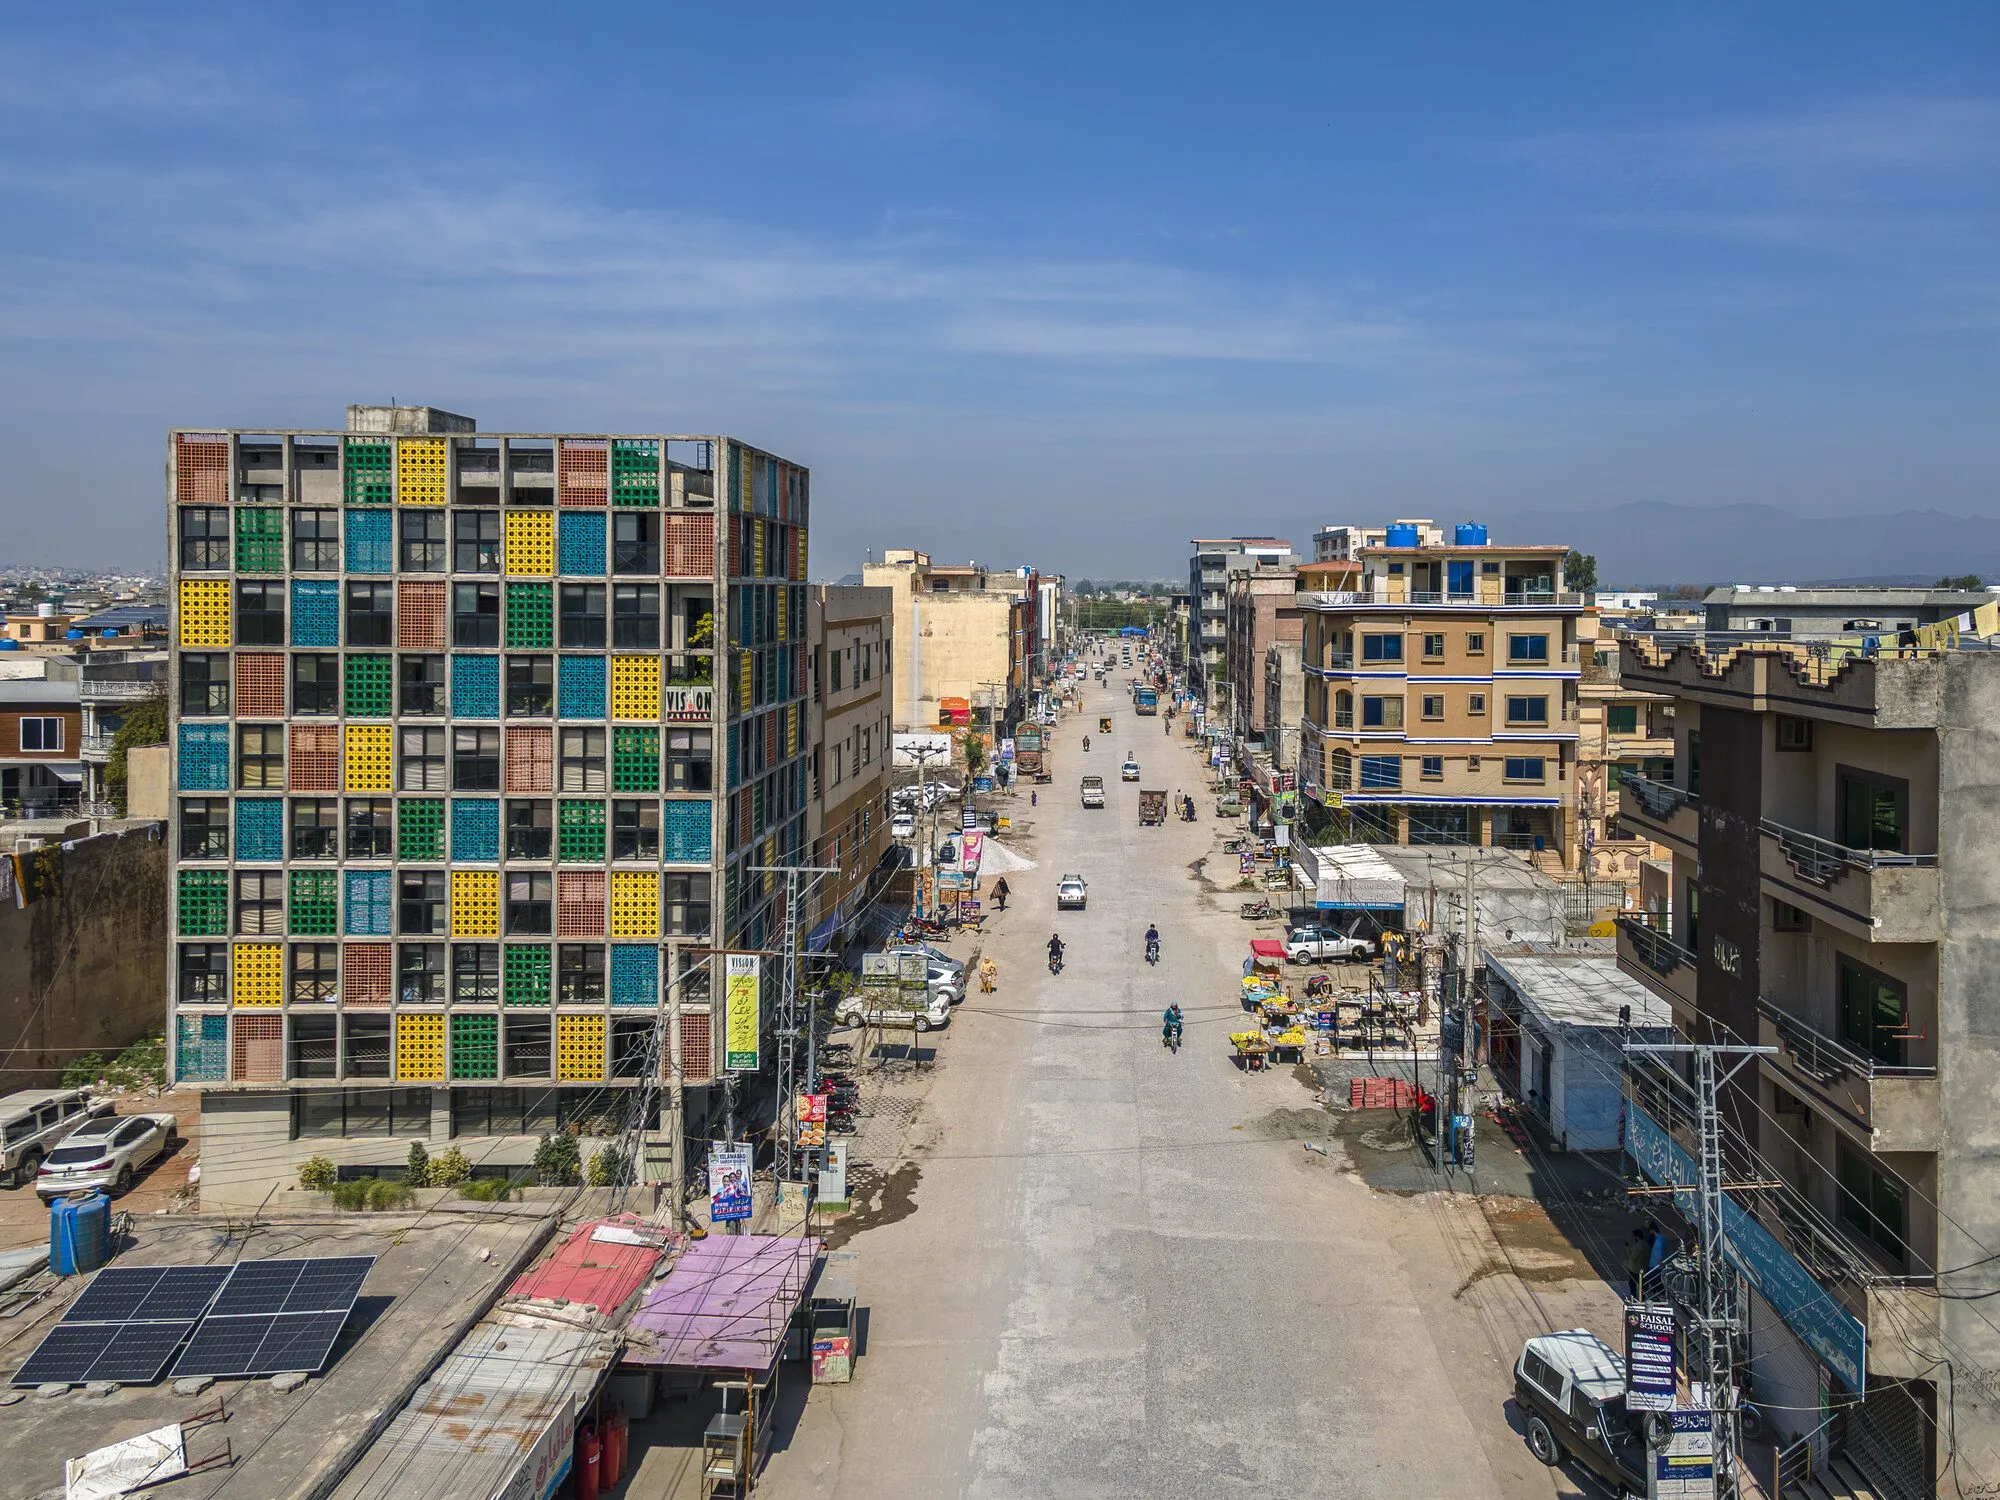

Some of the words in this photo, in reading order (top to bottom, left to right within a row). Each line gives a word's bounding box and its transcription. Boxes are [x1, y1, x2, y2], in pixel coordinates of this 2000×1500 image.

[667, 690, 711, 711] VISION
[731, 957, 754, 968] VISION
[1640, 1314, 1674, 1325] FAISAL
[1640, 1323, 1674, 1332] SCHOOL
